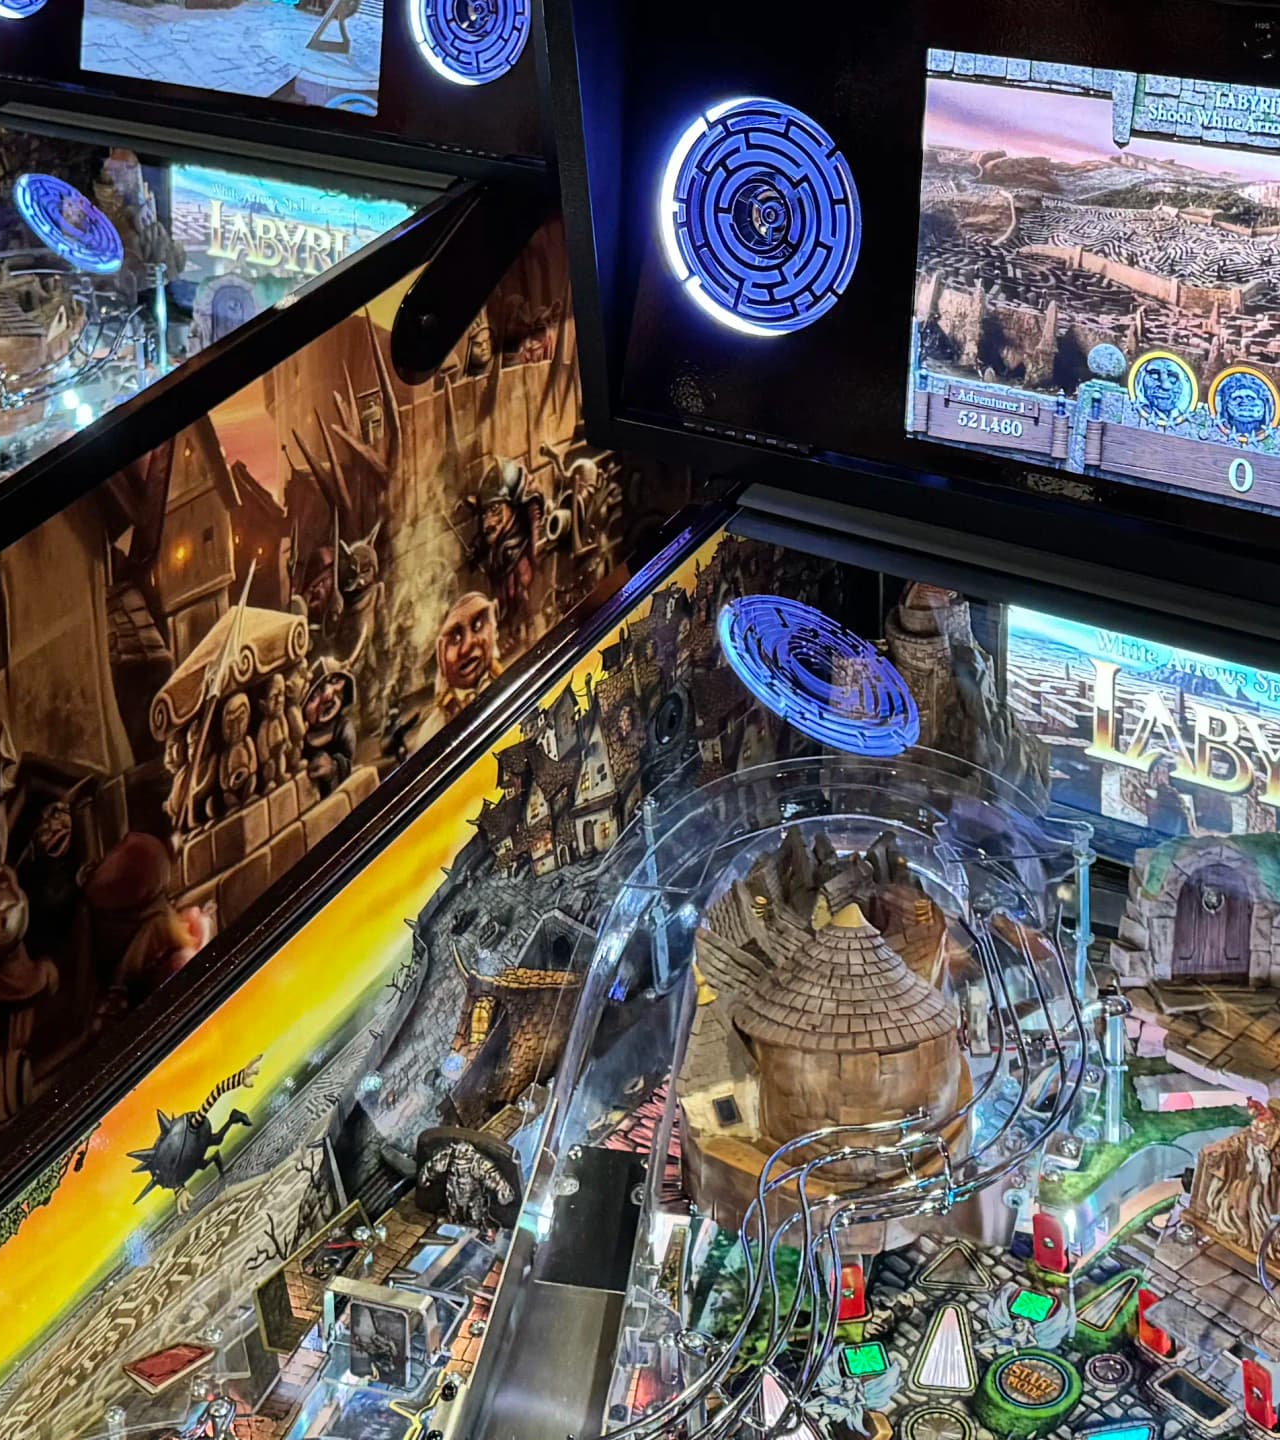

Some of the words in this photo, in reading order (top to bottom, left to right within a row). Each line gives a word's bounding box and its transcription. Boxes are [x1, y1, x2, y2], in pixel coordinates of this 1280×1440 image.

[1148, 104, 1194, 124] Shoot
[1195, 109, 1242, 130] White
[958, 389, 1019, 411] Adventurer
[958, 410, 1023, 437] 521,460
[1229, 458, 1254, 493] 0
[1096, 630, 1158, 665] White
[1166, 650, 1247, 688] Arrows
